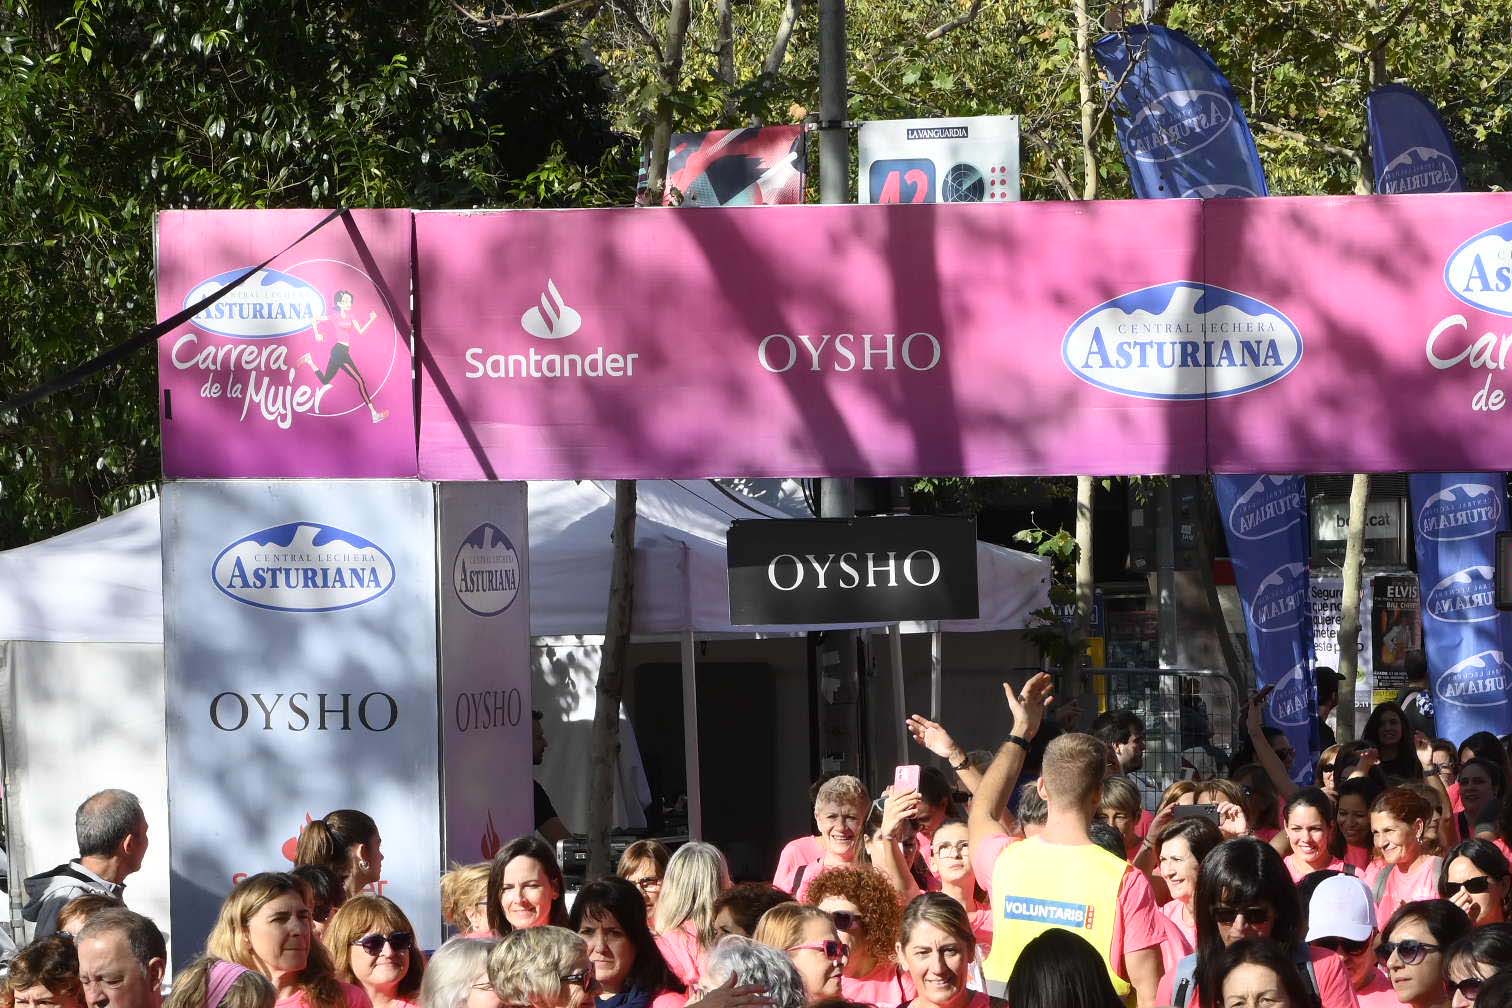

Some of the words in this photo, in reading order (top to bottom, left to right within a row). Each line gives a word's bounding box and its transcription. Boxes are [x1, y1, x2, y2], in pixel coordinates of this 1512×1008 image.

[1117, 322, 1193, 334] CENTRAL
[1200, 320, 1276, 334] LECHERA
[171, 333, 289, 370] Carrera
[465, 346, 639, 379] Santander
[757, 332, 941, 373] OYSHO
[1081, 325, 1284, 369] ASTURIANA
[201, 372, 222, 398] de
[227, 372, 242, 398] la
[240, 367, 333, 429] Mujer
[1471, 373, 1506, 413] de
[226, 556, 383, 590] ASTURIANA
[254, 553, 312, 562] CENTRAL
[318, 553, 376, 562] LECHERA
[767, 549, 941, 591] OYSHO
[458, 560, 517, 593] ASTURIANA
[1386, 585, 1418, 599] ELVIS
[209, 691, 399, 732] OYSHO
[455, 687, 522, 733] OYSHO
[1005, 901, 1085, 924] VOLUNTARIS
